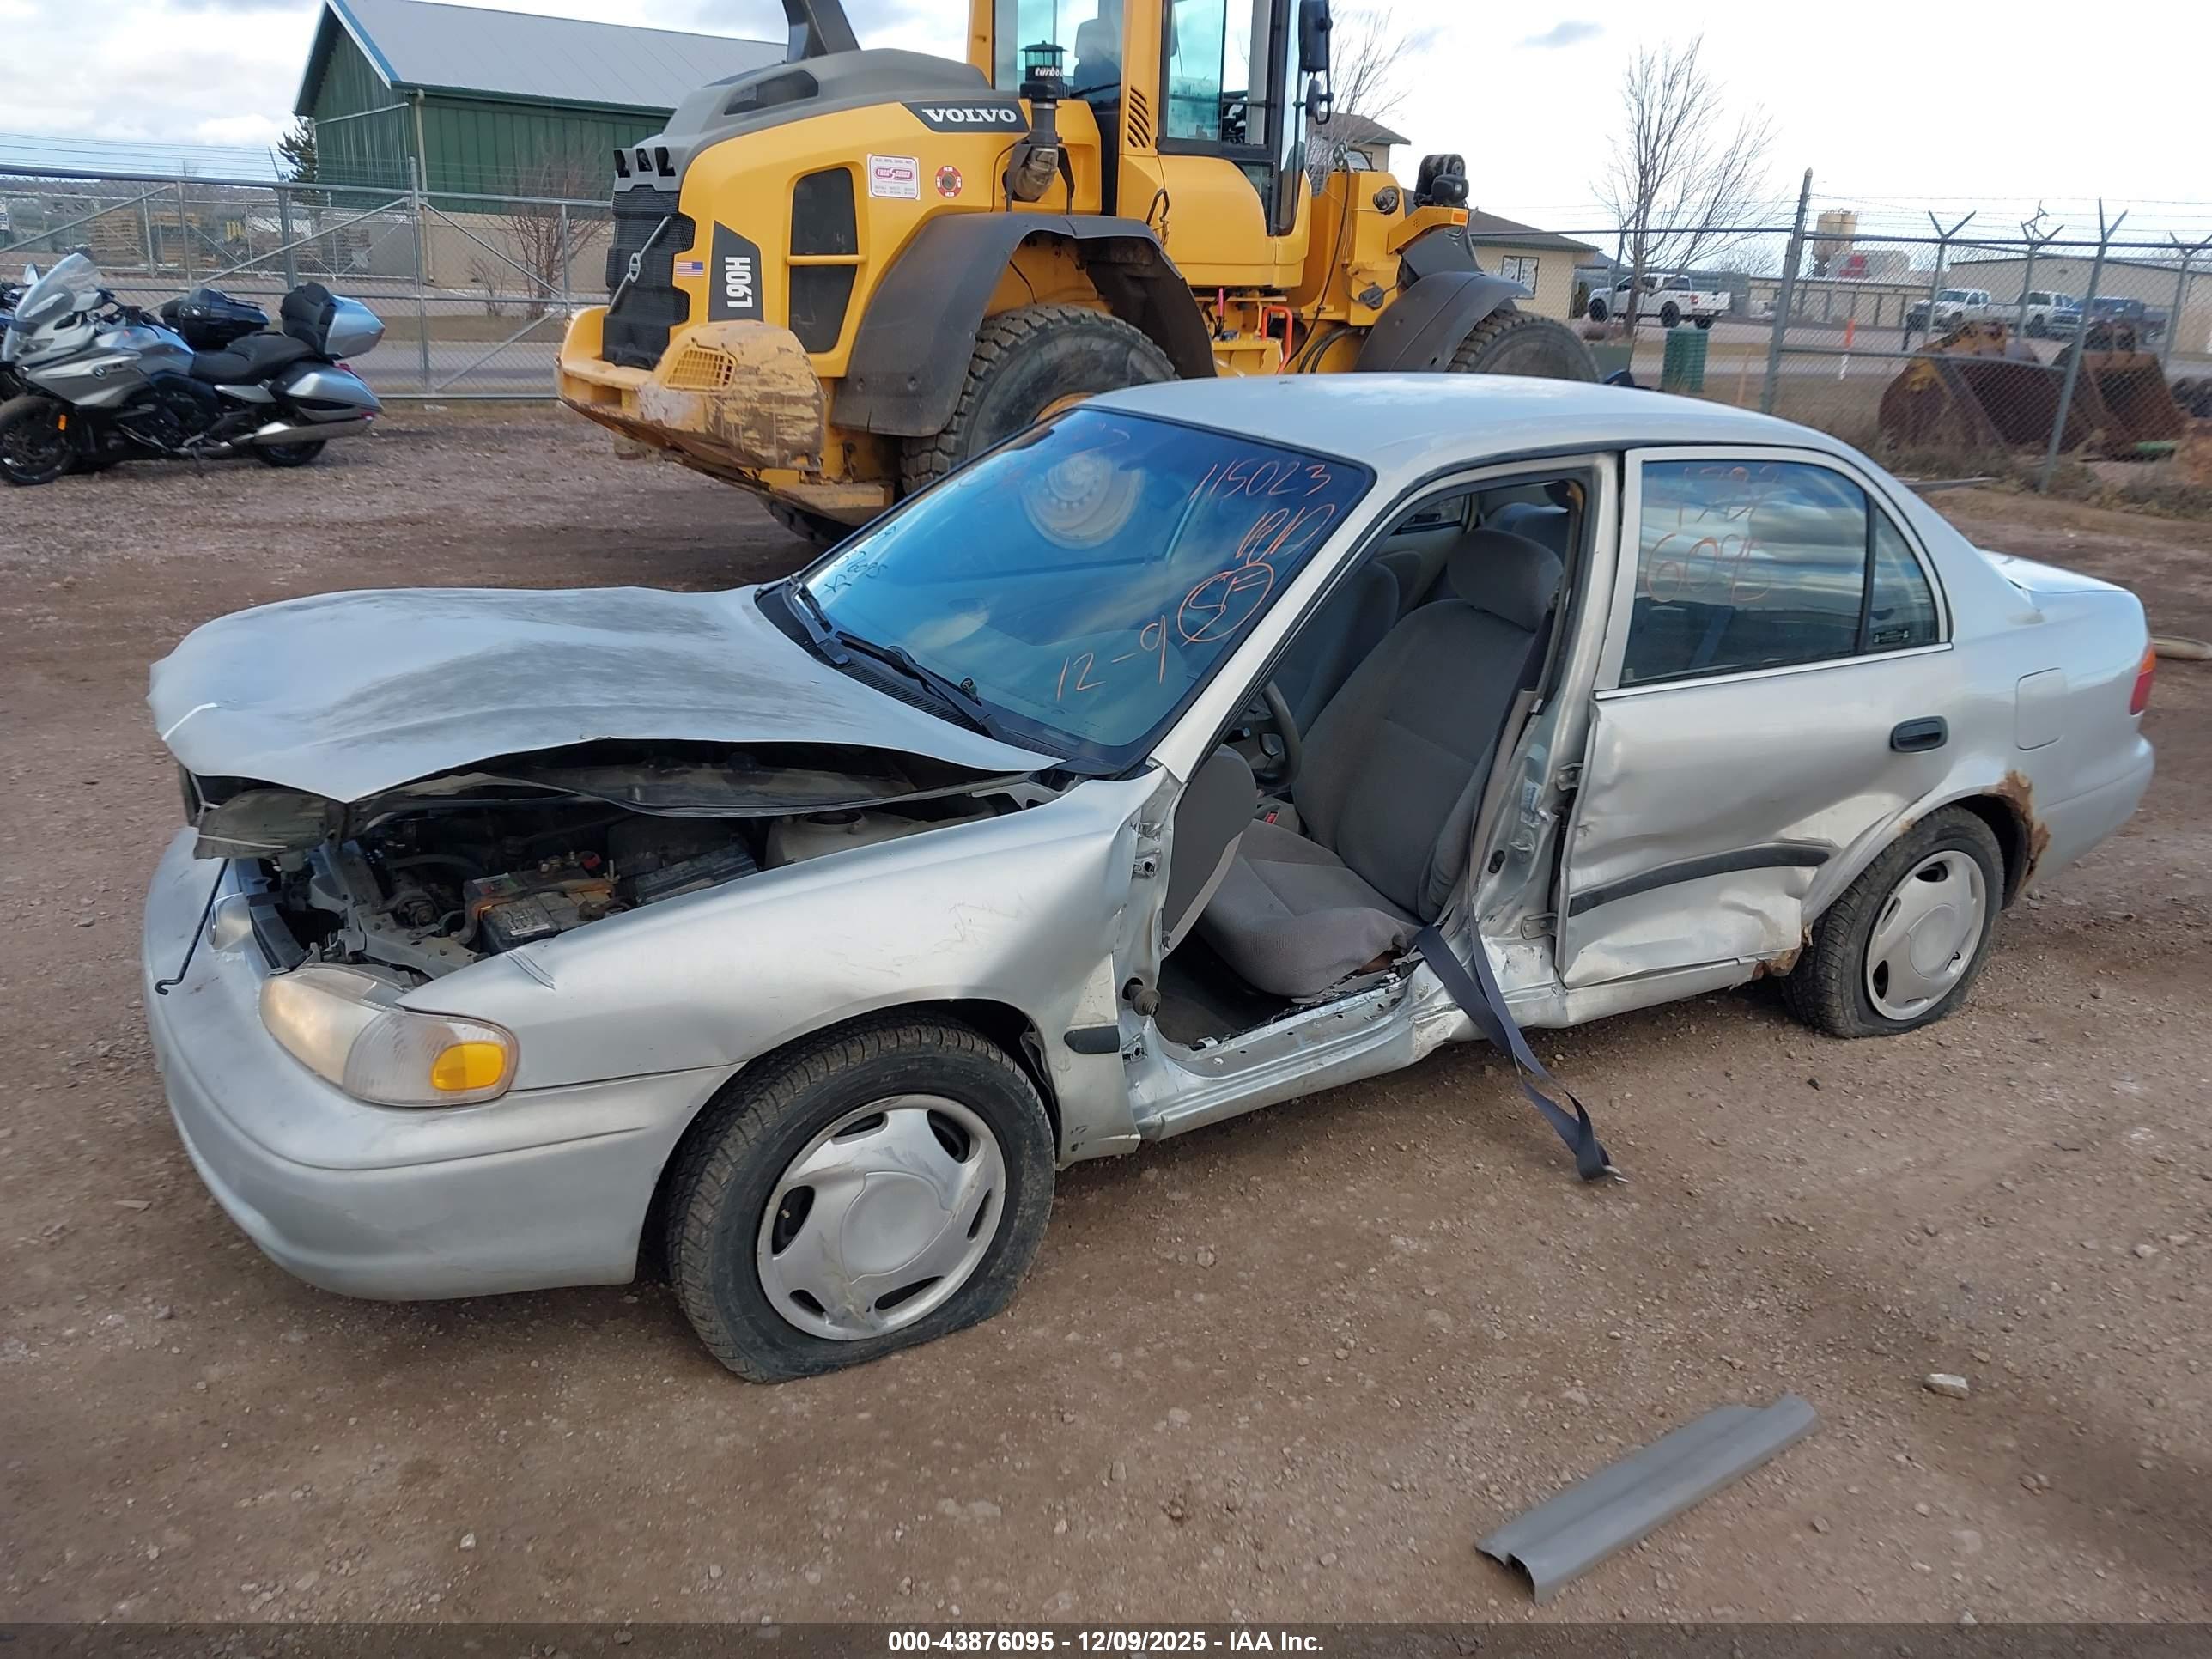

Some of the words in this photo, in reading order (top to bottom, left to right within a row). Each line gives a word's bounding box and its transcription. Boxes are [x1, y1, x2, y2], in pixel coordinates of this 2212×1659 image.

[921, 108, 1017, 123] VOLVO
[724, 256, 753, 307] L90H
[1188, 458, 1331, 503] 115023
